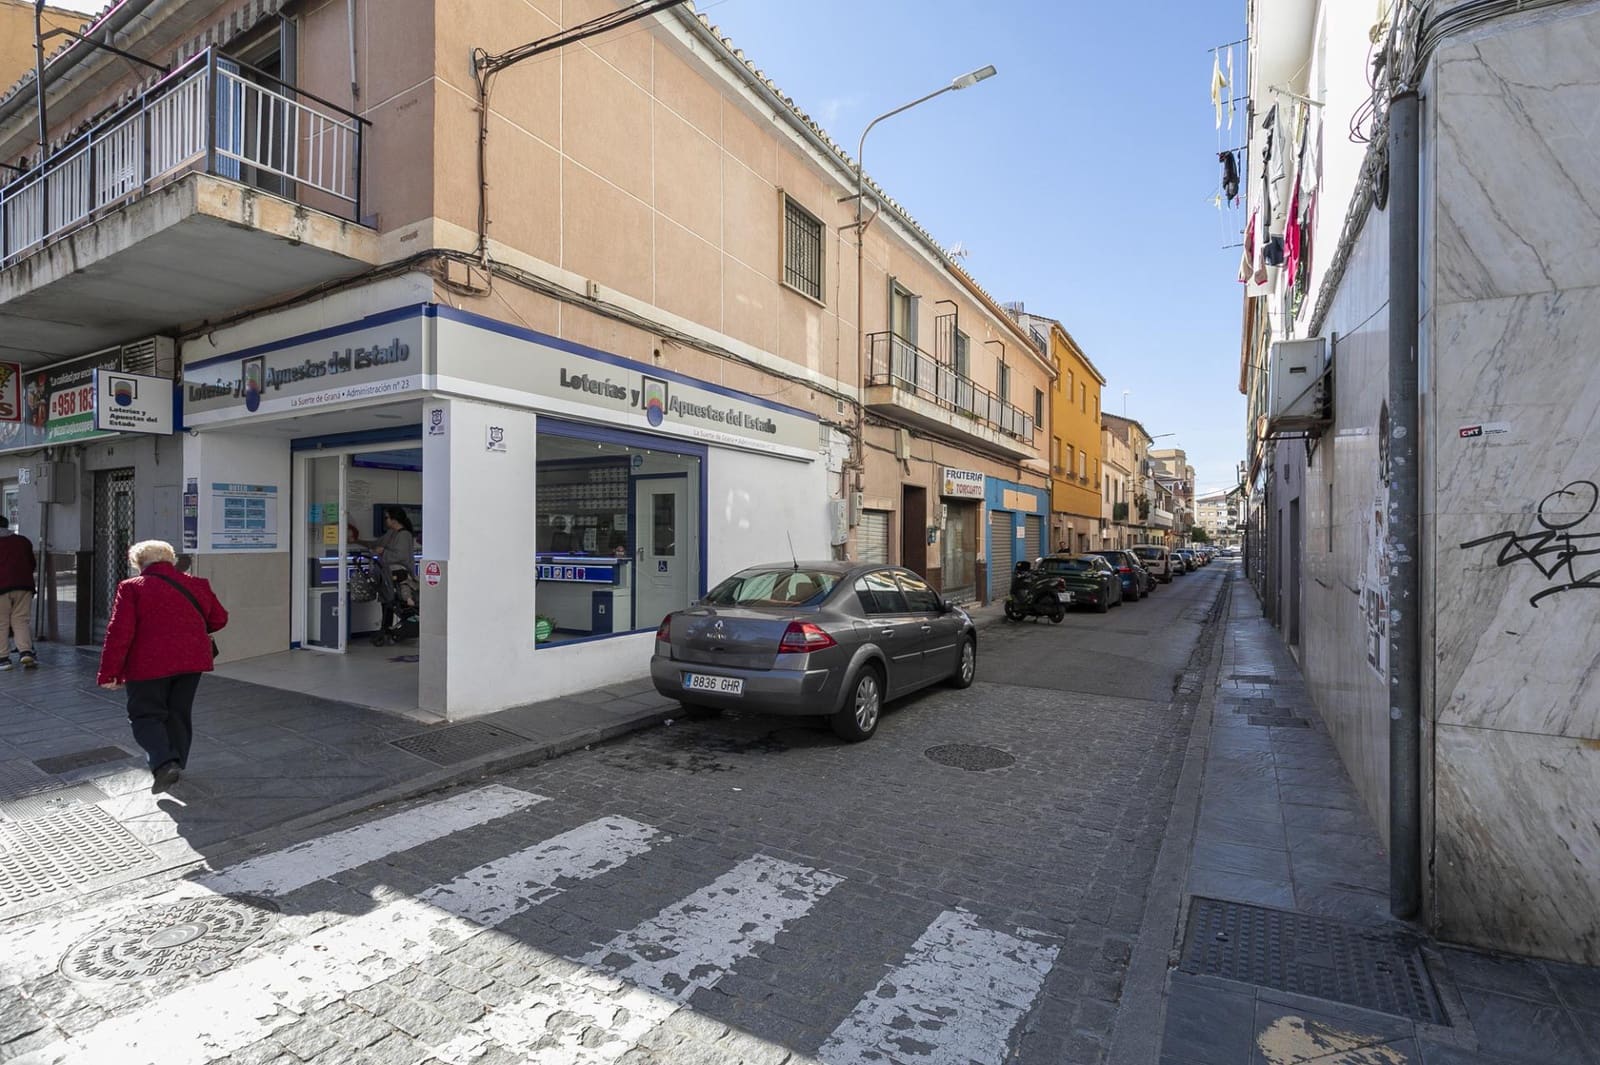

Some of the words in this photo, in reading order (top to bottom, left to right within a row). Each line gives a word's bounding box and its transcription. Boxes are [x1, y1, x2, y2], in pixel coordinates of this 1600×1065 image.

[233, 379, 242, 398] y
[266, 359, 326, 390] Apuestas
[328, 348, 352, 375] del
[354, 337, 410, 370] Estado
[58, 391, 76, 416] 958
[291, 399, 297, 407] La
[298, 395, 315, 406] Suerte
[316, 394, 323, 402] de
[324, 392, 341, 402] Grana
[346, 382, 391, 398] Administración
[401, 379, 410, 389] 23
[560, 367, 627, 400] Loterías
[631, 388, 641, 407] y
[669, 395, 725, 420] Apuestas
[725, 408, 742, 427] del
[744, 414, 777, 434] Estado
[109, 413, 144, 422] Apuestas
[946, 469, 983, 481] FRUTERIA
[693, 675, 717, 689] 8836
[721, 679, 740, 692] GHR
